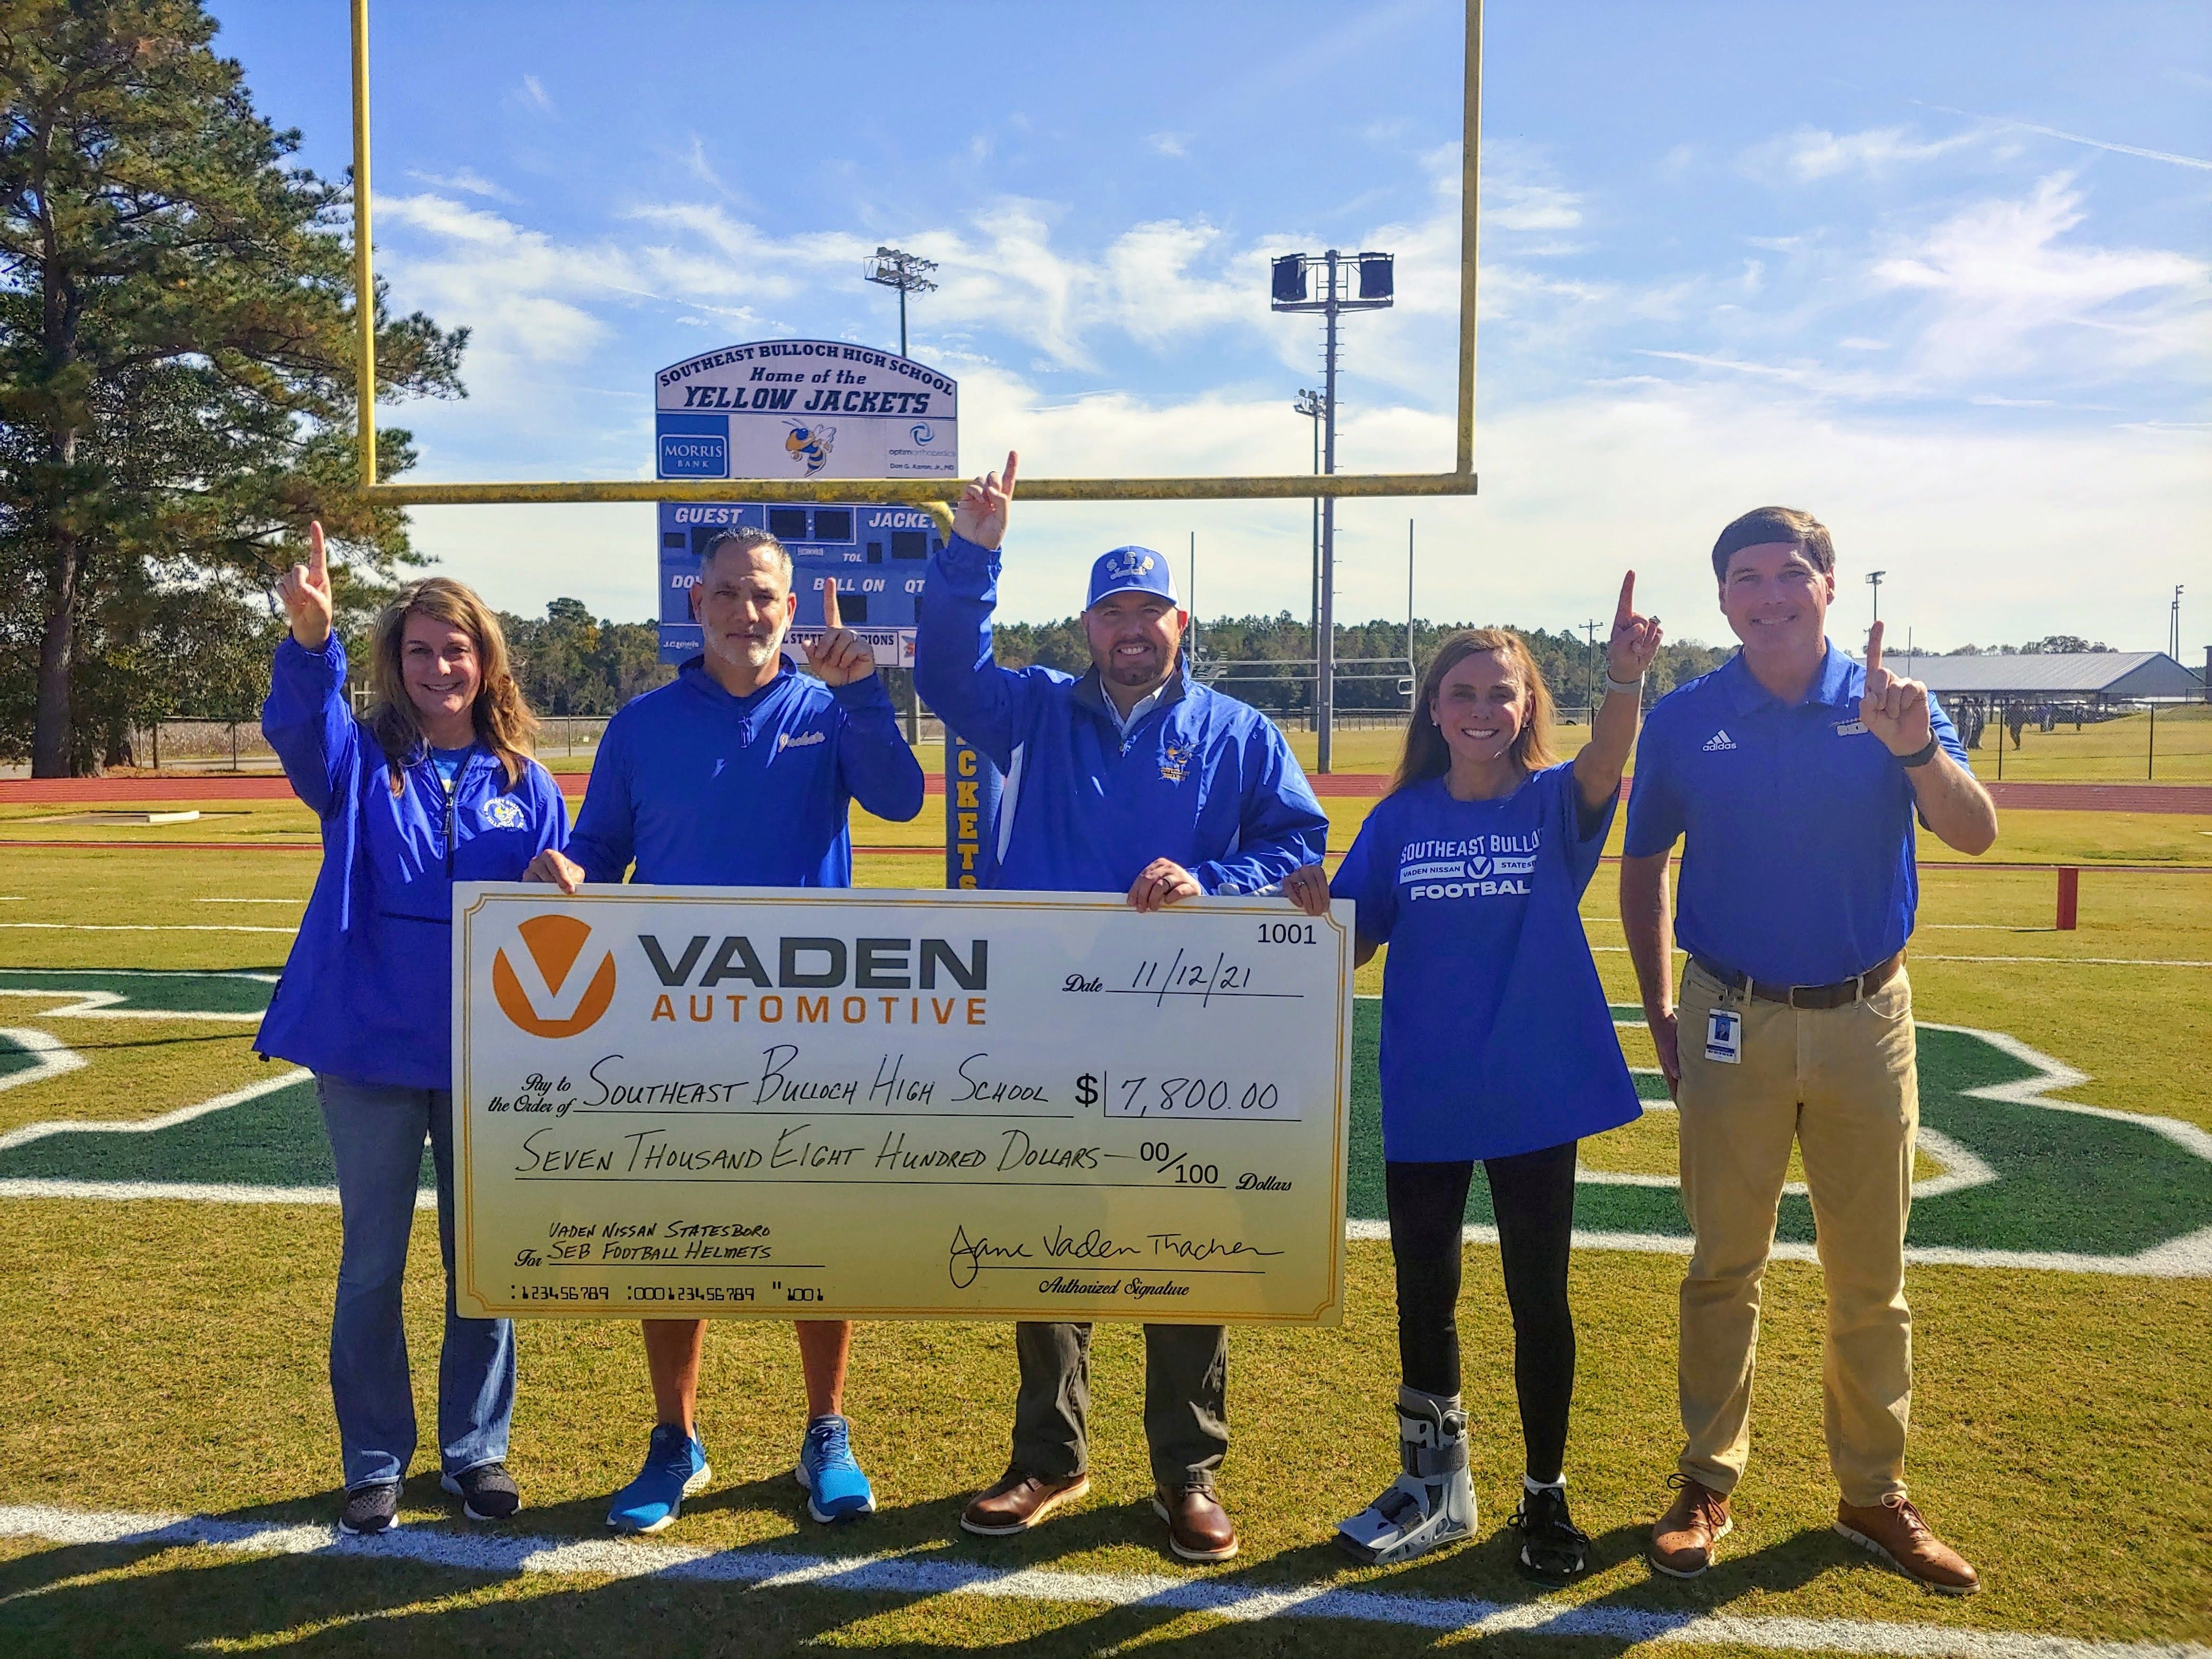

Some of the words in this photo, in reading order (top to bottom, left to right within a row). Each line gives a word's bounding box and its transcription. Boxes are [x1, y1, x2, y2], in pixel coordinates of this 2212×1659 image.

[660, 347, 754, 387] SOUTHEAST
[759, 345, 838, 358] BULLOCH
[843, 348, 887, 368] HIGH
[889, 360, 954, 396] SCHOOL
[749, 367, 805, 382] Home
[811, 369, 832, 383] of
[837, 370, 866, 384] the
[684, 386, 798, 410] YELLOW
[804, 390, 931, 414] JACKETS
[665, 444, 722, 458] MORRIS
[678, 460, 709, 468] BANK
[675, 508, 743, 524] GUEST
[843, 553, 862, 562] TOL
[813, 578, 855, 591] BLL
[862, 578, 886, 592] ON
[1702, 743, 1737, 752] adidas
[1400, 835, 1485, 864] SOUTHEAST
[1403, 868, 1427, 878] VADEN
[1257, 923, 1317, 945] 1001
[638, 935, 988, 990] VADEN
[1062, 974, 1103, 993] Date
[1132, 948, 1251, 1008] 11/12/21
[651, 994, 986, 1025] AUTOMOTIVE
[521, 1073, 552, 1097] Pay
[556, 1076, 571, 1092] to
[1075, 1073, 1098, 1108] $
[488, 1097, 510, 1112] the
[513, 1095, 554, 1112] Order
[557, 1097, 577, 1118] of
[1121, 1077, 1278, 1117] 7,800.00
[515, 1128, 613, 1171] SEVEN
[625, 1129, 763, 1172] THOUSAND
[771, 1124, 865, 1168] EIGHT
[875, 1131, 986, 1170] HUNDRED
[1236, 1173, 1292, 1191] Dollars
[547, 1240, 591, 1260] SEB
[602, 1242, 679, 1260] FOOTBALL
[1043, 1225, 1141, 1258] Vaden
[514, 1249, 542, 1267] For
[1039, 1276, 1121, 1294] Authorized
[1125, 1277, 1190, 1299] Signature
